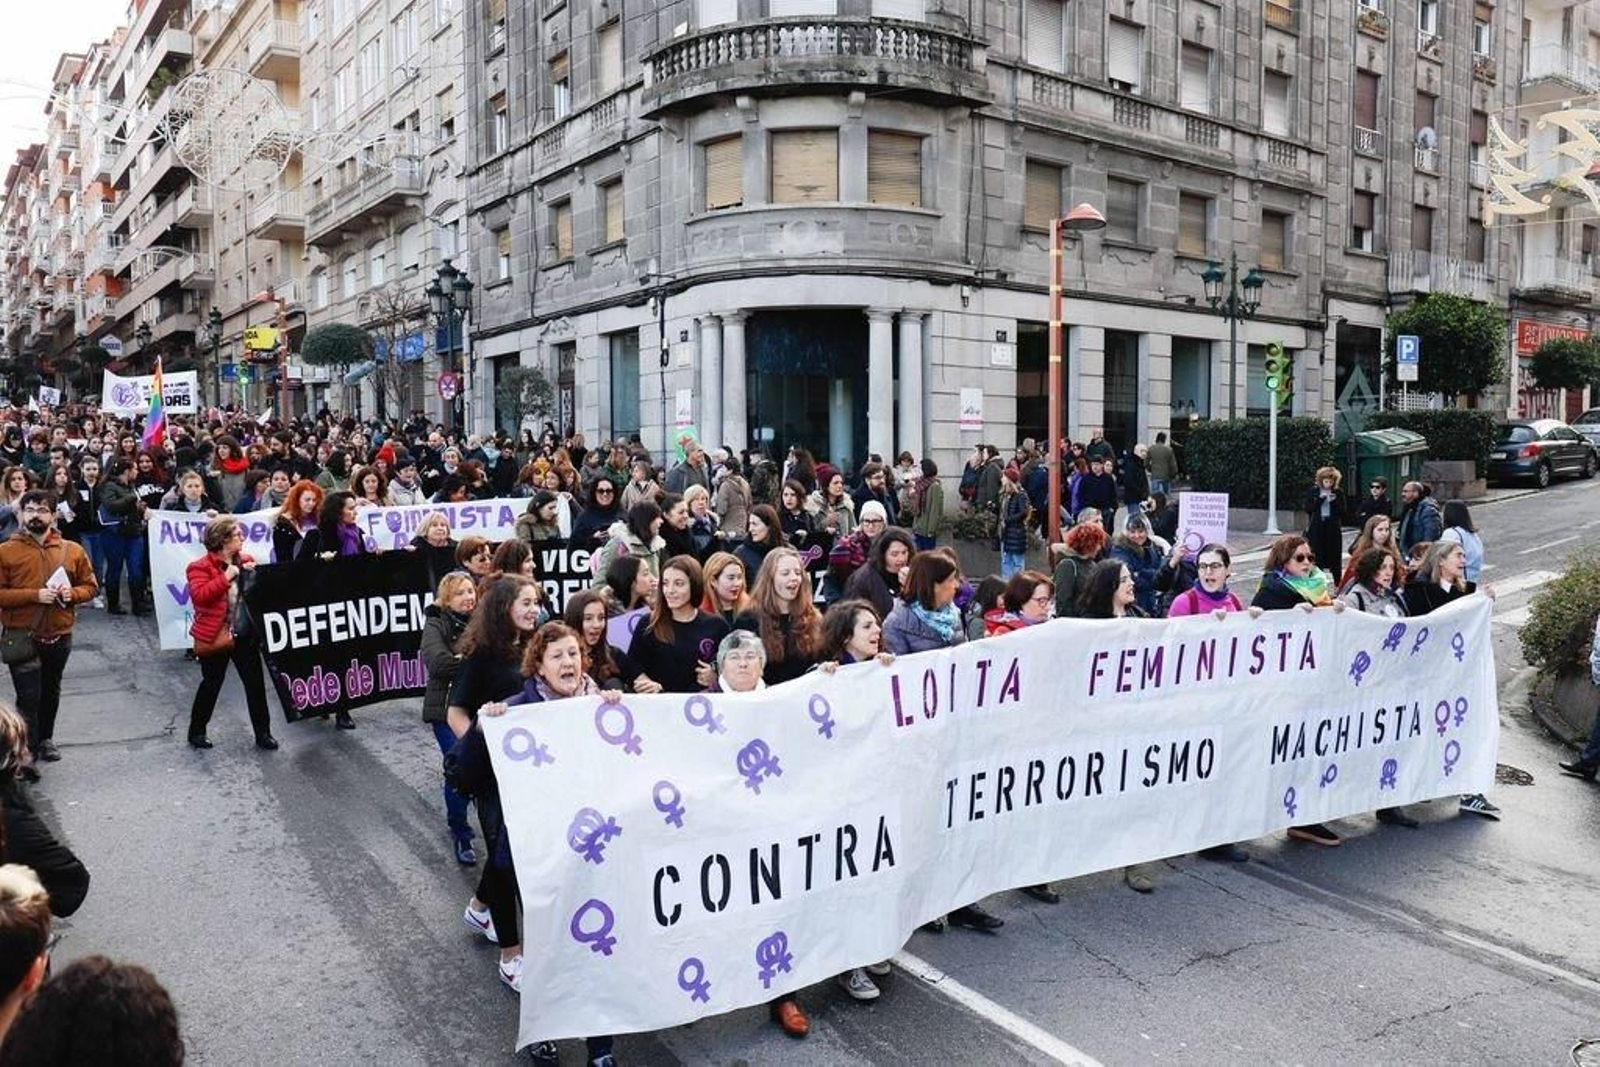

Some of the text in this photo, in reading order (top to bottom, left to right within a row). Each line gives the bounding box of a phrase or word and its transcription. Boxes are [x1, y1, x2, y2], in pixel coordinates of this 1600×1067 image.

[1402, 339, 1414, 359] P
[345, 658, 374, 698] de
[891, 631, 1317, 728] LOITA FEMINISTA
[652, 702, 1421, 927] CONTRA TERRORISMO MACHISTA
